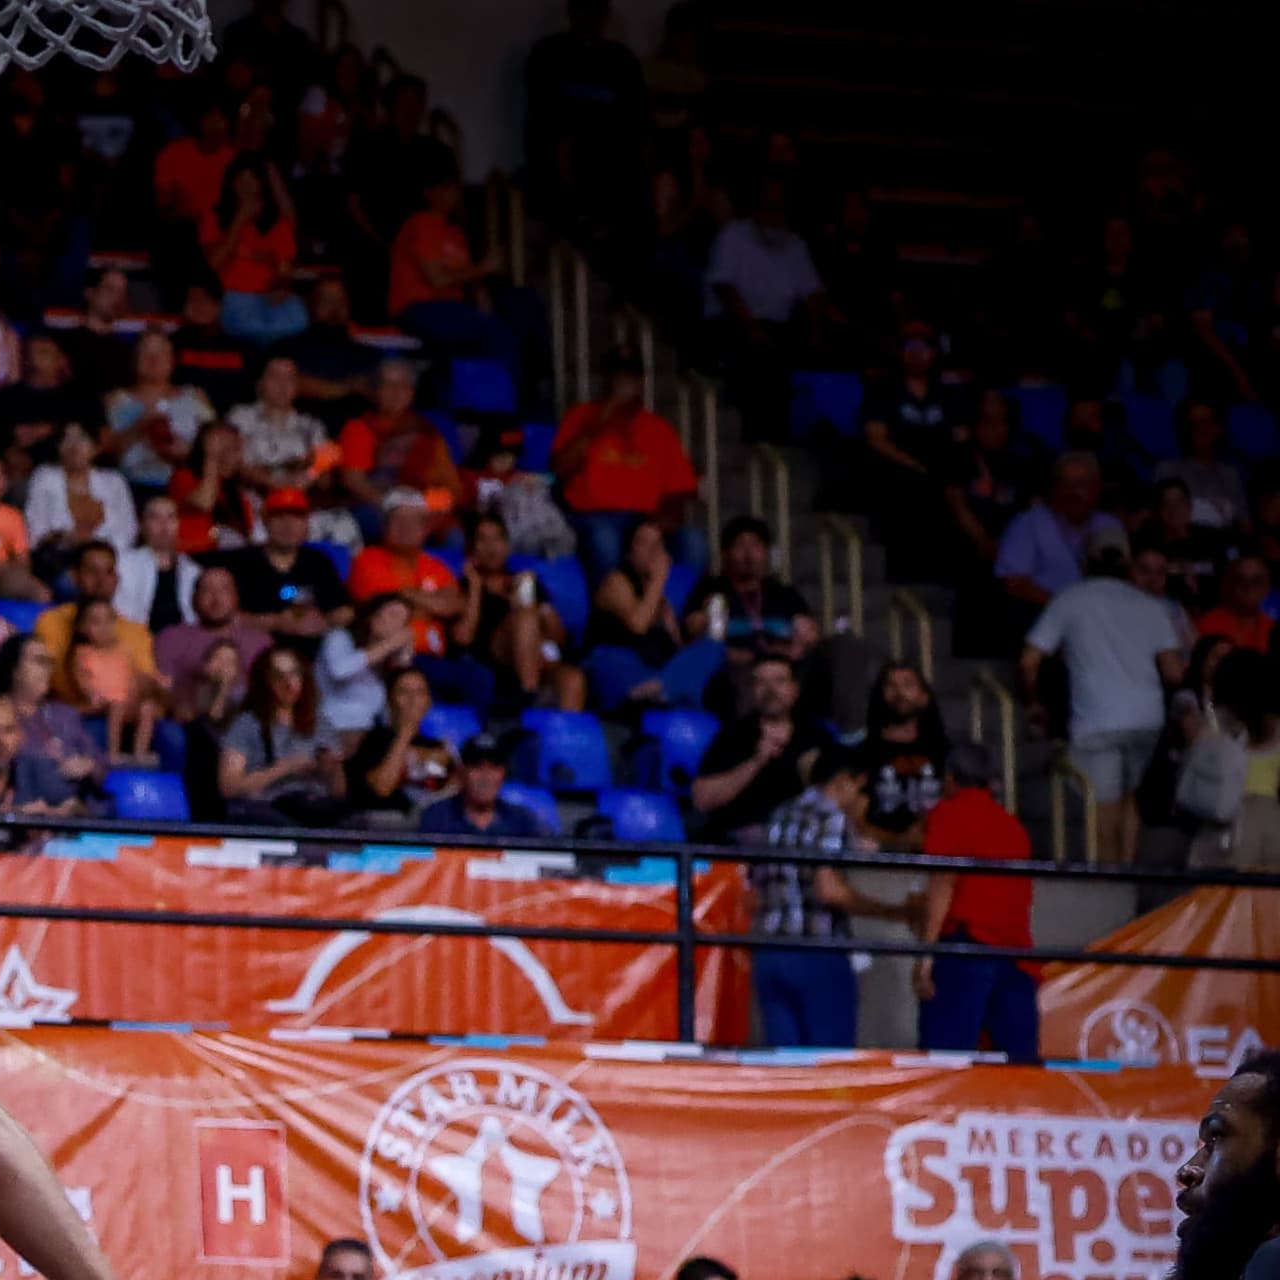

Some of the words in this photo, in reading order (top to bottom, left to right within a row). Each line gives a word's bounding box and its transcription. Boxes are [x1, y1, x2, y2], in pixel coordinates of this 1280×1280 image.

[376, 1071, 483, 1169] STAR
[494, 1072, 618, 1177] MILK
[215, 1163, 267, 1225] H
[903, 1138, 1174, 1262] Supe
